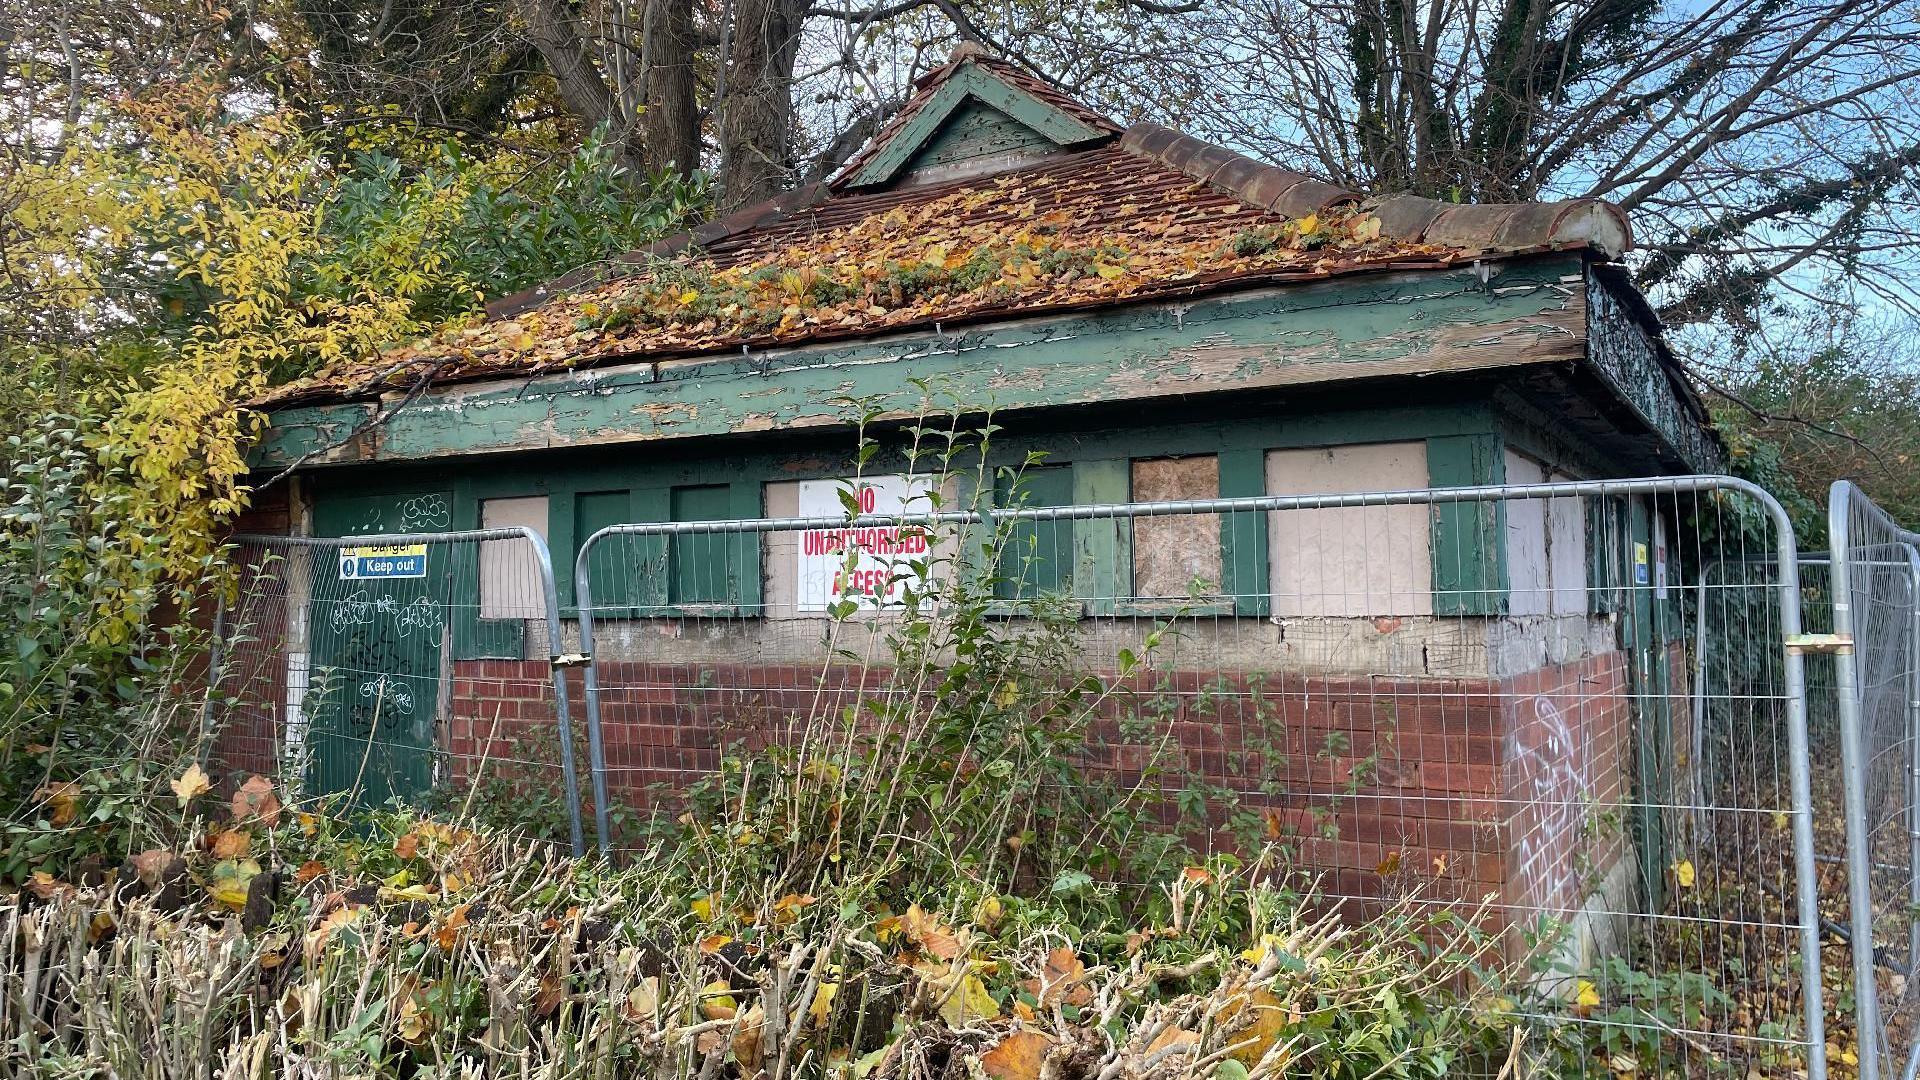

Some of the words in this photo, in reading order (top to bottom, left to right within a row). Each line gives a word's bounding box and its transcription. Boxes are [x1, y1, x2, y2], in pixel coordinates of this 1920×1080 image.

[853, 488, 875, 513] NO
[366, 559, 393, 575] Keep
[397, 558, 415, 571] out
